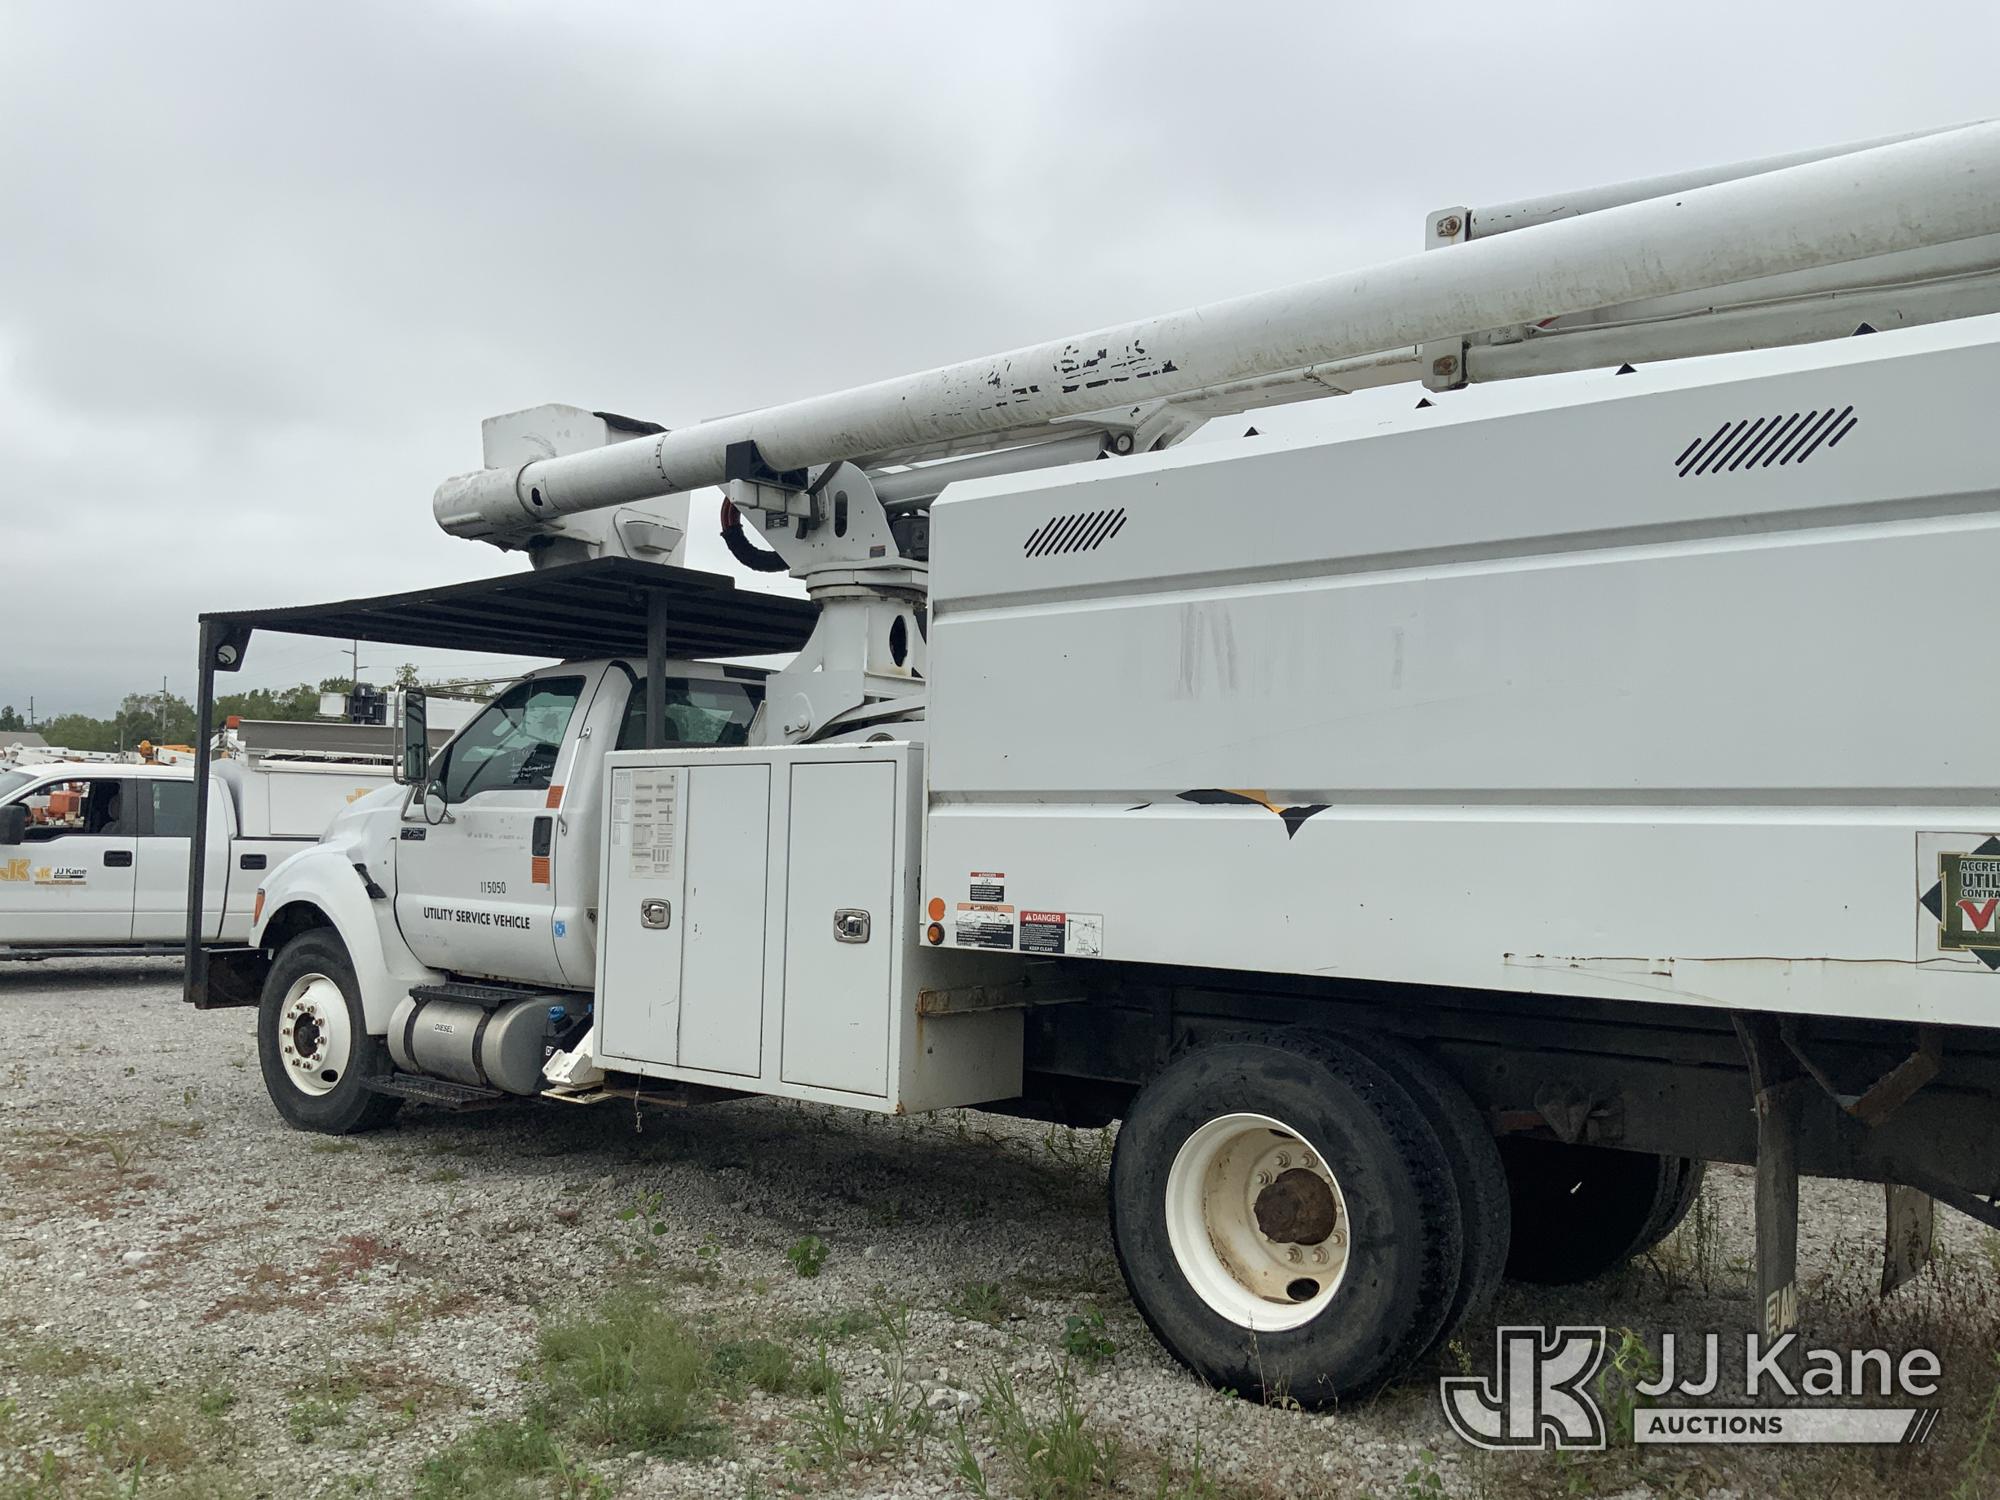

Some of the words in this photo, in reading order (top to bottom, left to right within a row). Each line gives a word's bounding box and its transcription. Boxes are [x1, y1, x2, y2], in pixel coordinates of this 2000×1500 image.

[65, 867, 87, 875] Kane
[480, 881, 506, 894] 115050
[423, 906, 454, 921] UTILITY
[456, 909, 491, 925] SERVICE
[493, 913, 531, 930] VEHICLE
[1032, 913, 1061, 922] DANGER
[434, 1023, 453, 1033] DIESEL
